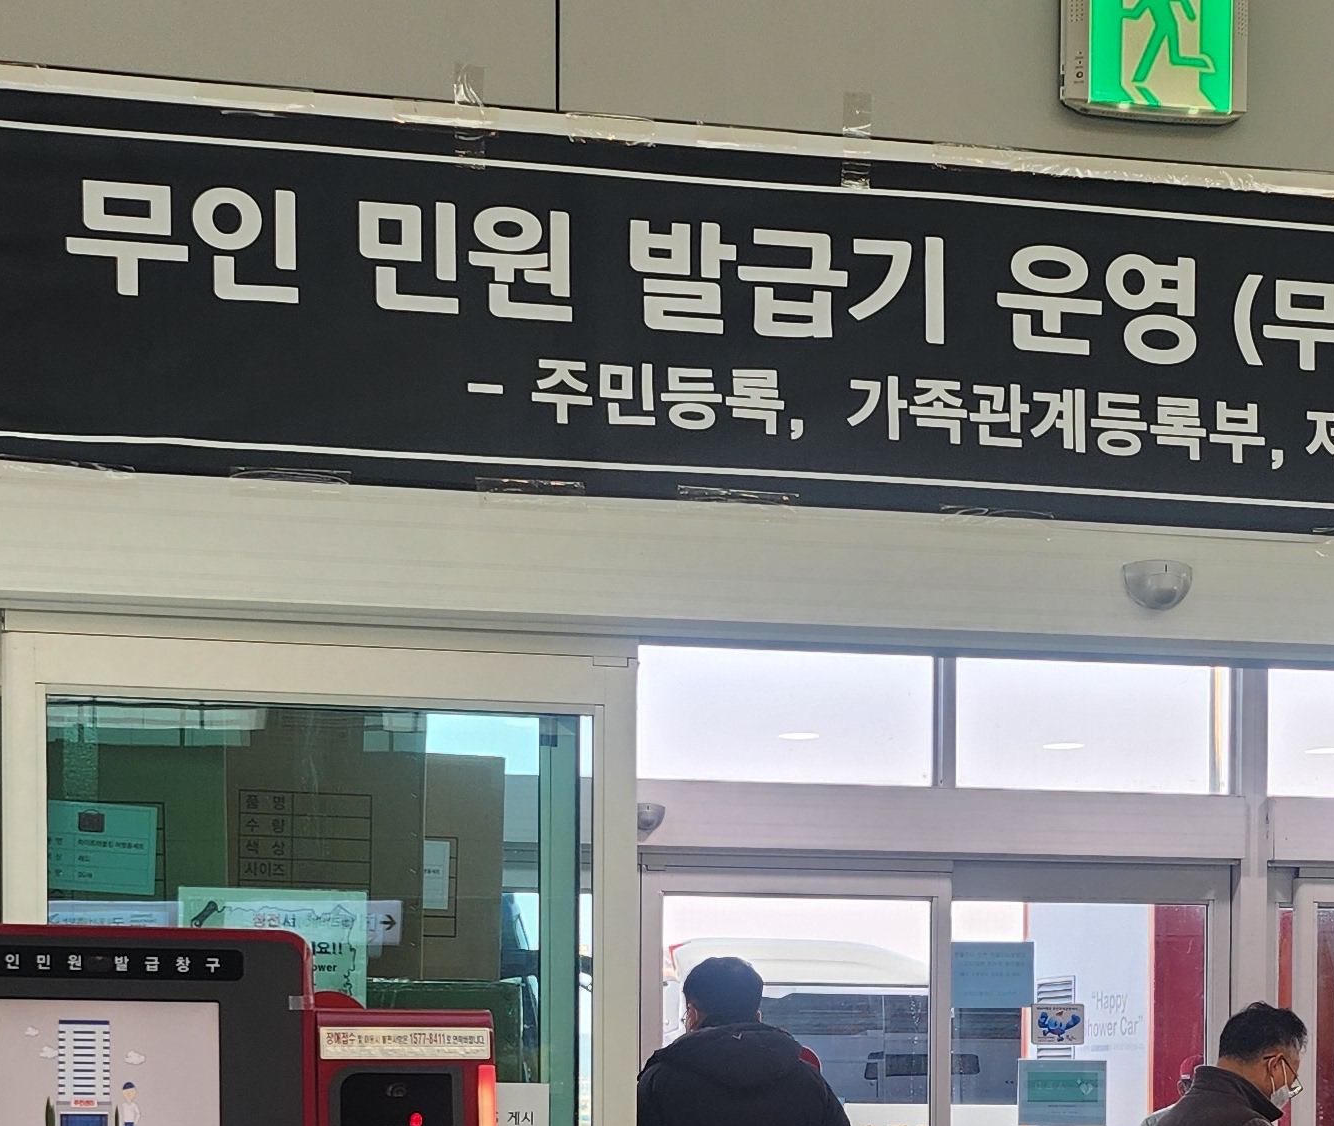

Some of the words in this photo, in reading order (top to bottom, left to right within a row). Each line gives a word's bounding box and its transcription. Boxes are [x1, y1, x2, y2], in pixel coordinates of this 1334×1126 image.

[67, 178, 299, 305] 무인
[358, 201, 573, 323] 민원
[629, 217, 946, 344] 발급기
[995, 250, 1198, 355] 운영
[531, 359, 804, 440] 주민등록,
[845, 375, 1286, 470] 가족관계등록부,
[244, 860, 285, 878] 사이즈
[1085, 1017, 1117, 1037] hower
[507, 1111, 535, 1126] 게시
